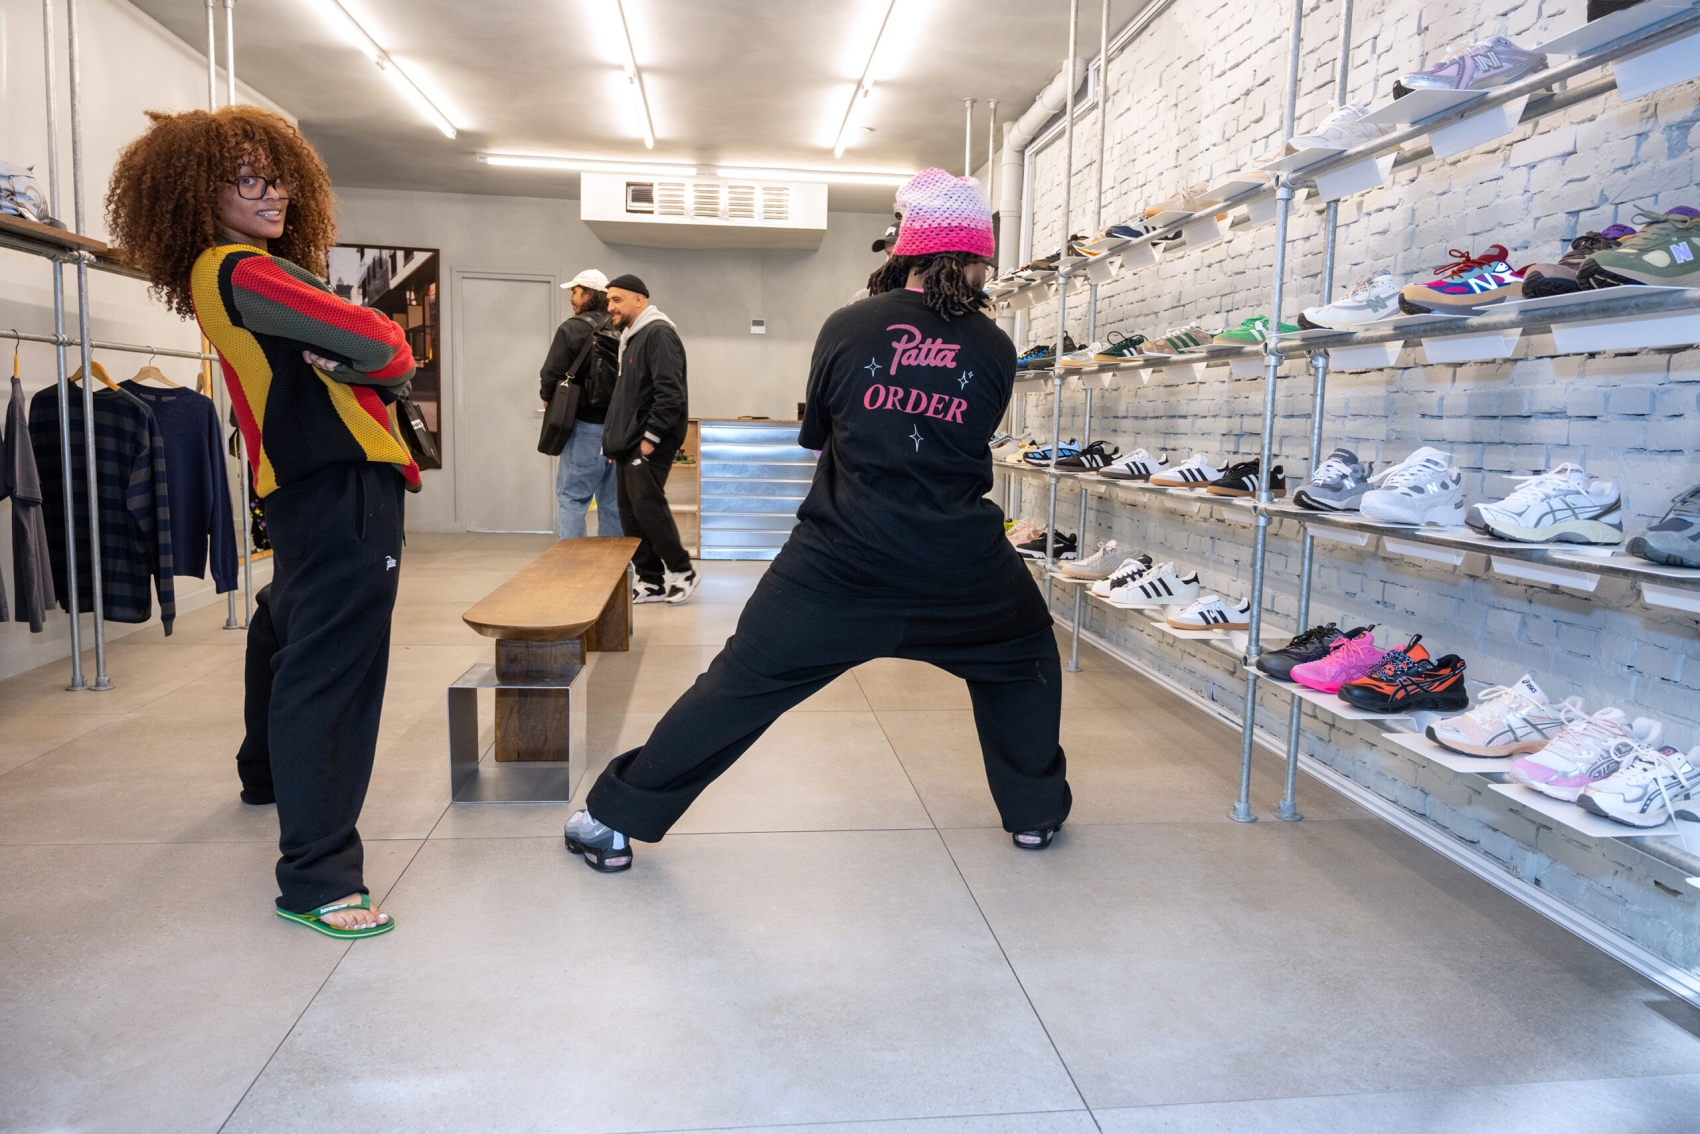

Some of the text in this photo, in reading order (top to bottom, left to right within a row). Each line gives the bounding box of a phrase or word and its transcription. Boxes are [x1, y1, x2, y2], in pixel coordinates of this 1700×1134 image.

[1668, 241, 1694, 264] N
[1468, 272, 1499, 294] N
[1367, 295, 1388, 313] N
[886, 324, 961, 376] Patta
[863, 384, 968, 424] ORDER
[1426, 482, 1439, 494] N
